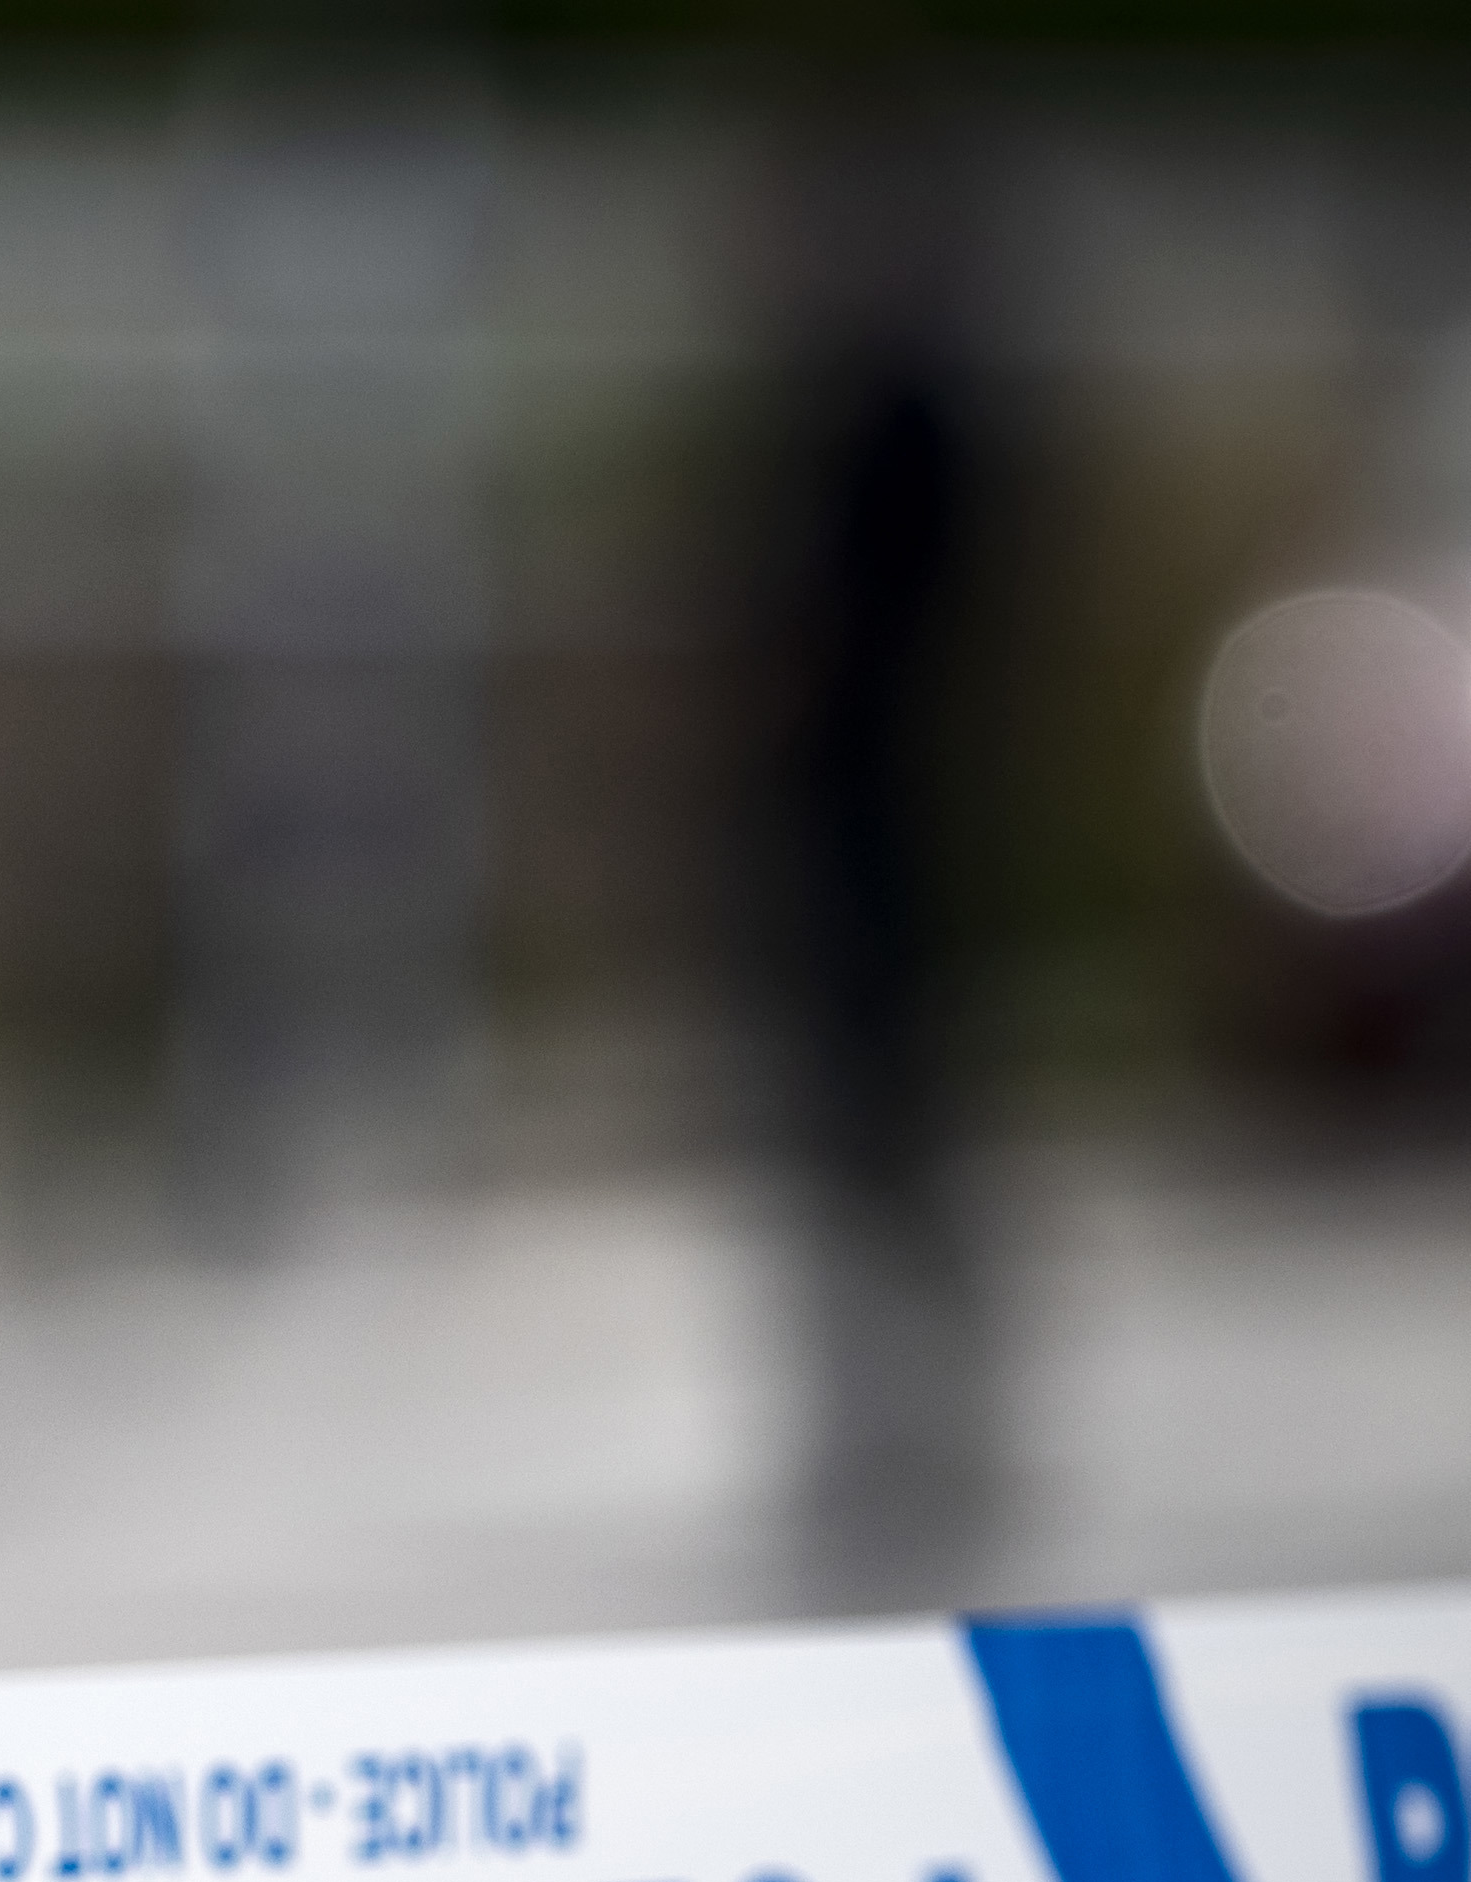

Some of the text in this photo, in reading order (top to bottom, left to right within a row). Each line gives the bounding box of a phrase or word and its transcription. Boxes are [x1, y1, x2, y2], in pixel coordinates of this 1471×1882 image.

[50, 1766, 186, 1880] NOT
[199, 1759, 300, 1874] DO
[350, 1740, 585, 1862] POLICE
